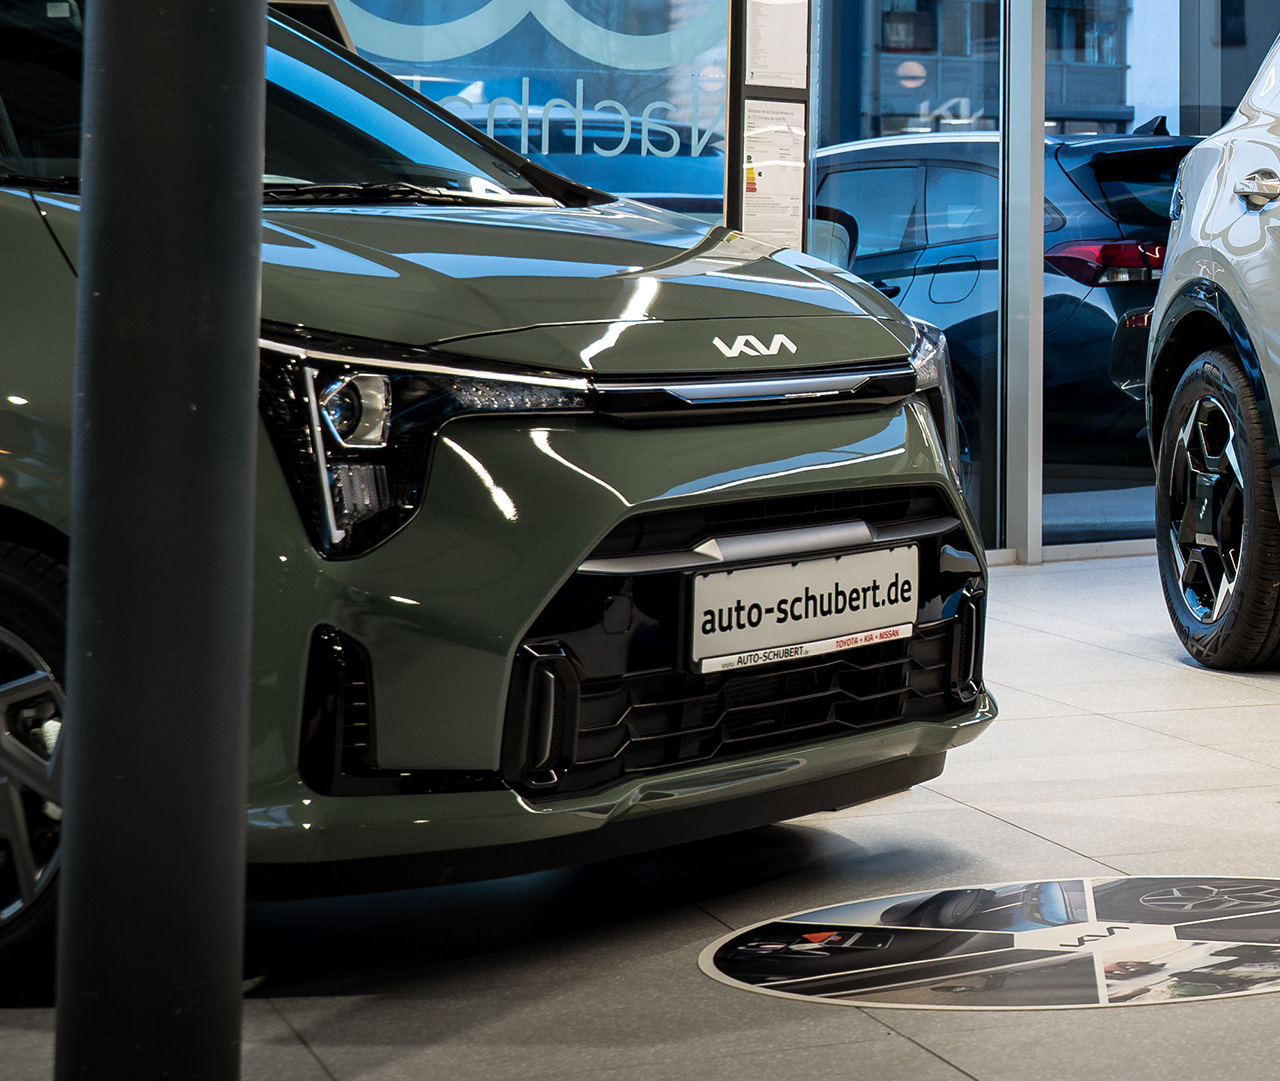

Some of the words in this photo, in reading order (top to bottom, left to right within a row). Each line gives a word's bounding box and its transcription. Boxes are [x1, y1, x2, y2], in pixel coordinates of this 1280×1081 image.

[712, 333, 797, 358] KIA
[702, 573, 912, 636] auto-schubert.de
[835, 636, 859, 649] TOYOTA
[864, 634, 874, 644] KIA
[879, 629, 900, 641] NISSAN
